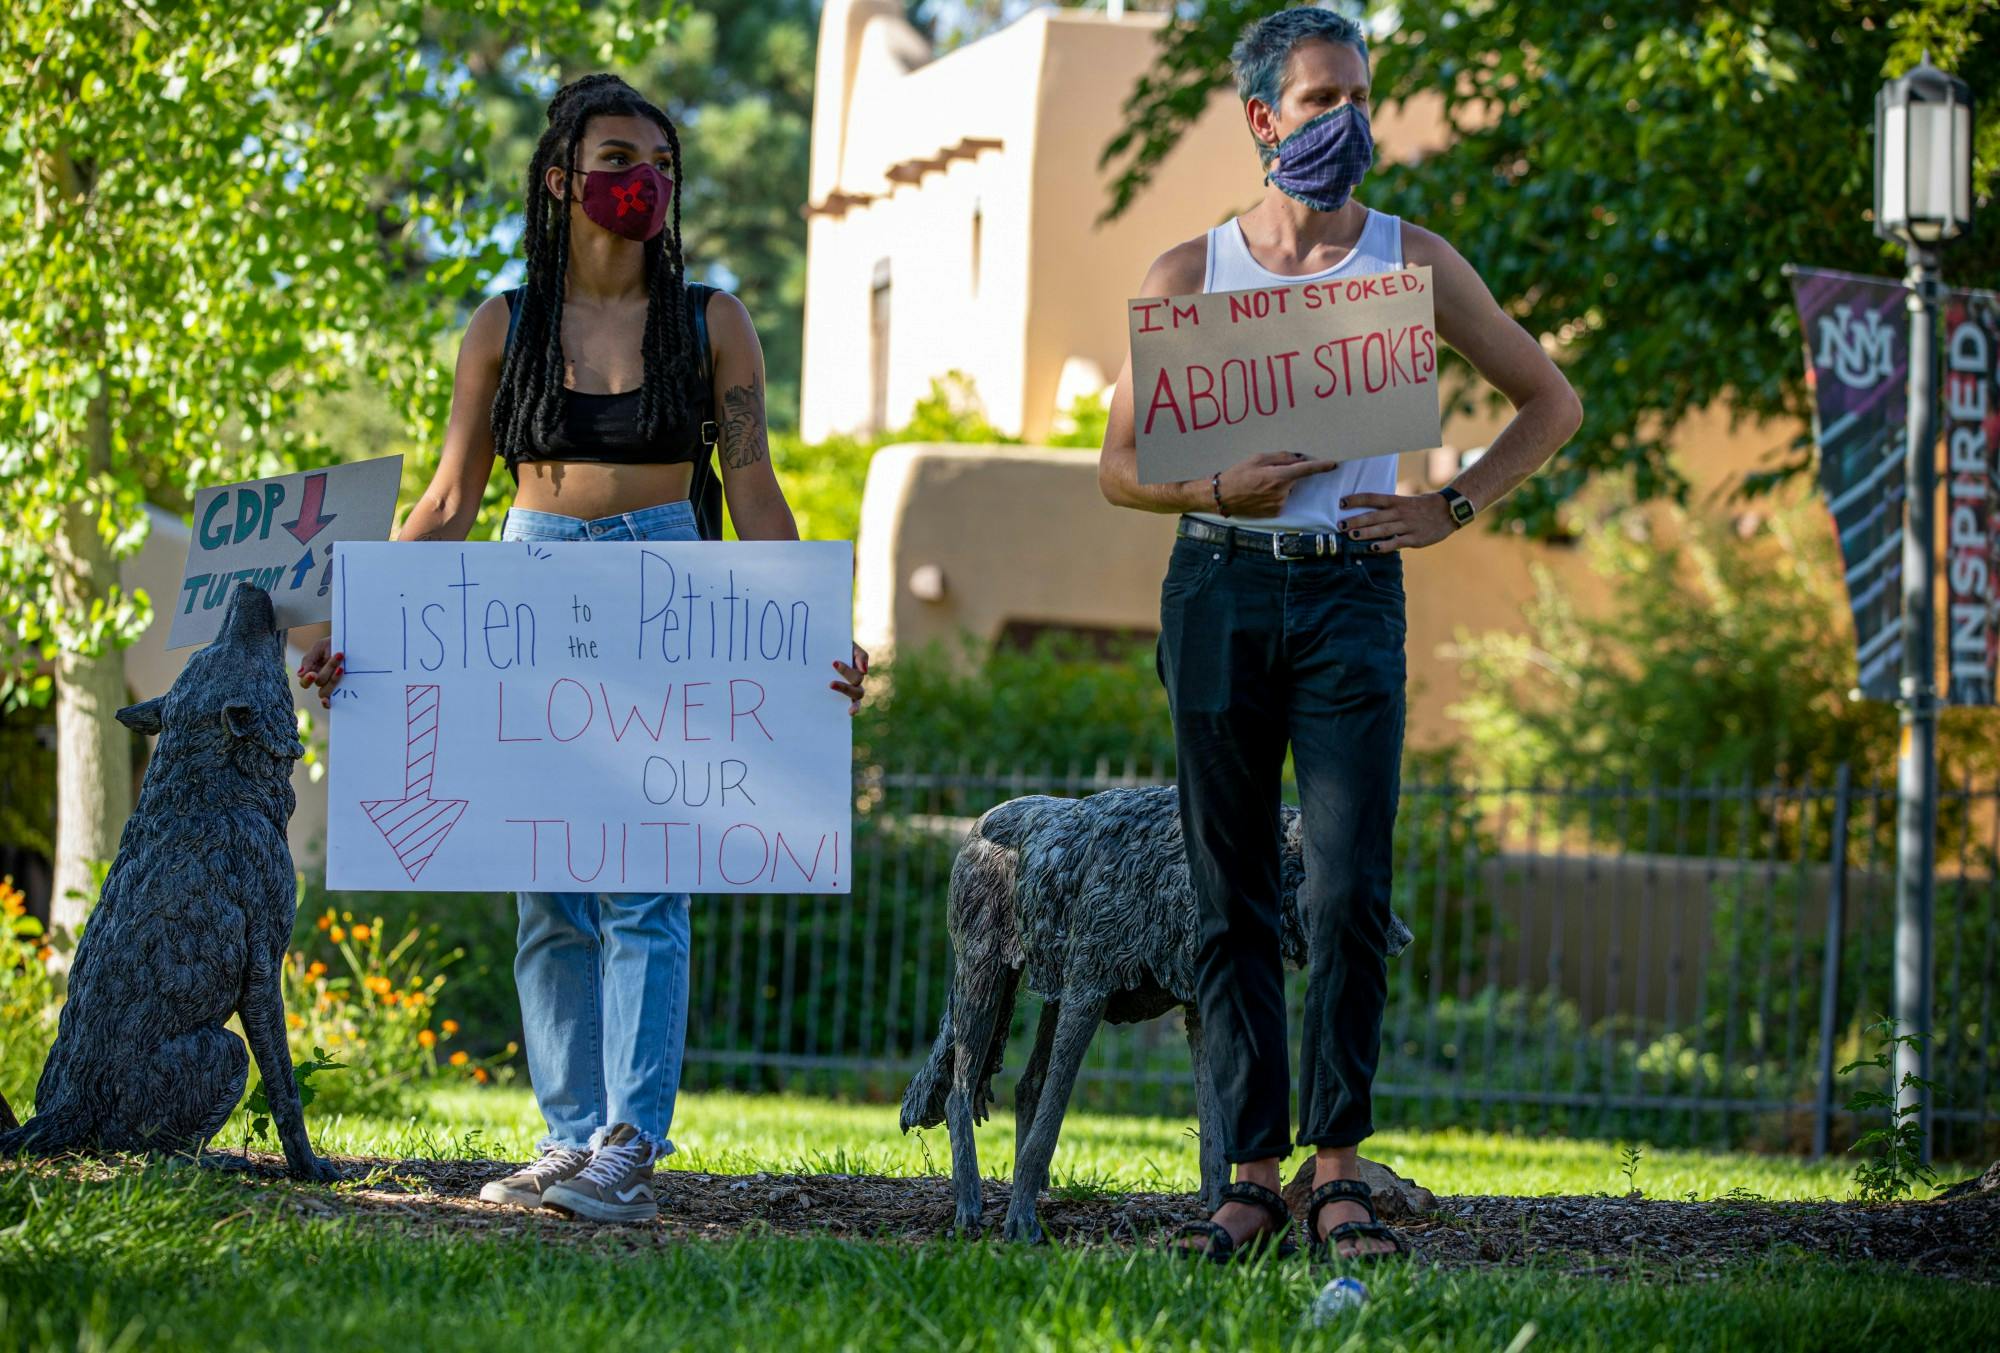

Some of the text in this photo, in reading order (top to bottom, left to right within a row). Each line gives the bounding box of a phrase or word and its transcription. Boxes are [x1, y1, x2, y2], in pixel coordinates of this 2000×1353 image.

[1132, 273, 1425, 333] I'M NOT STOKED,
[1143, 324, 1435, 434] ABOUT STOKES
[199, 483, 286, 551] GDP
[1950, 321, 1989, 680] INSPIRED
[342, 549, 810, 675] Listen to the Petition
[498, 678, 774, 742] LOWER
[642, 755, 757, 807] OUR
[504, 819, 840, 887] TUITION!
